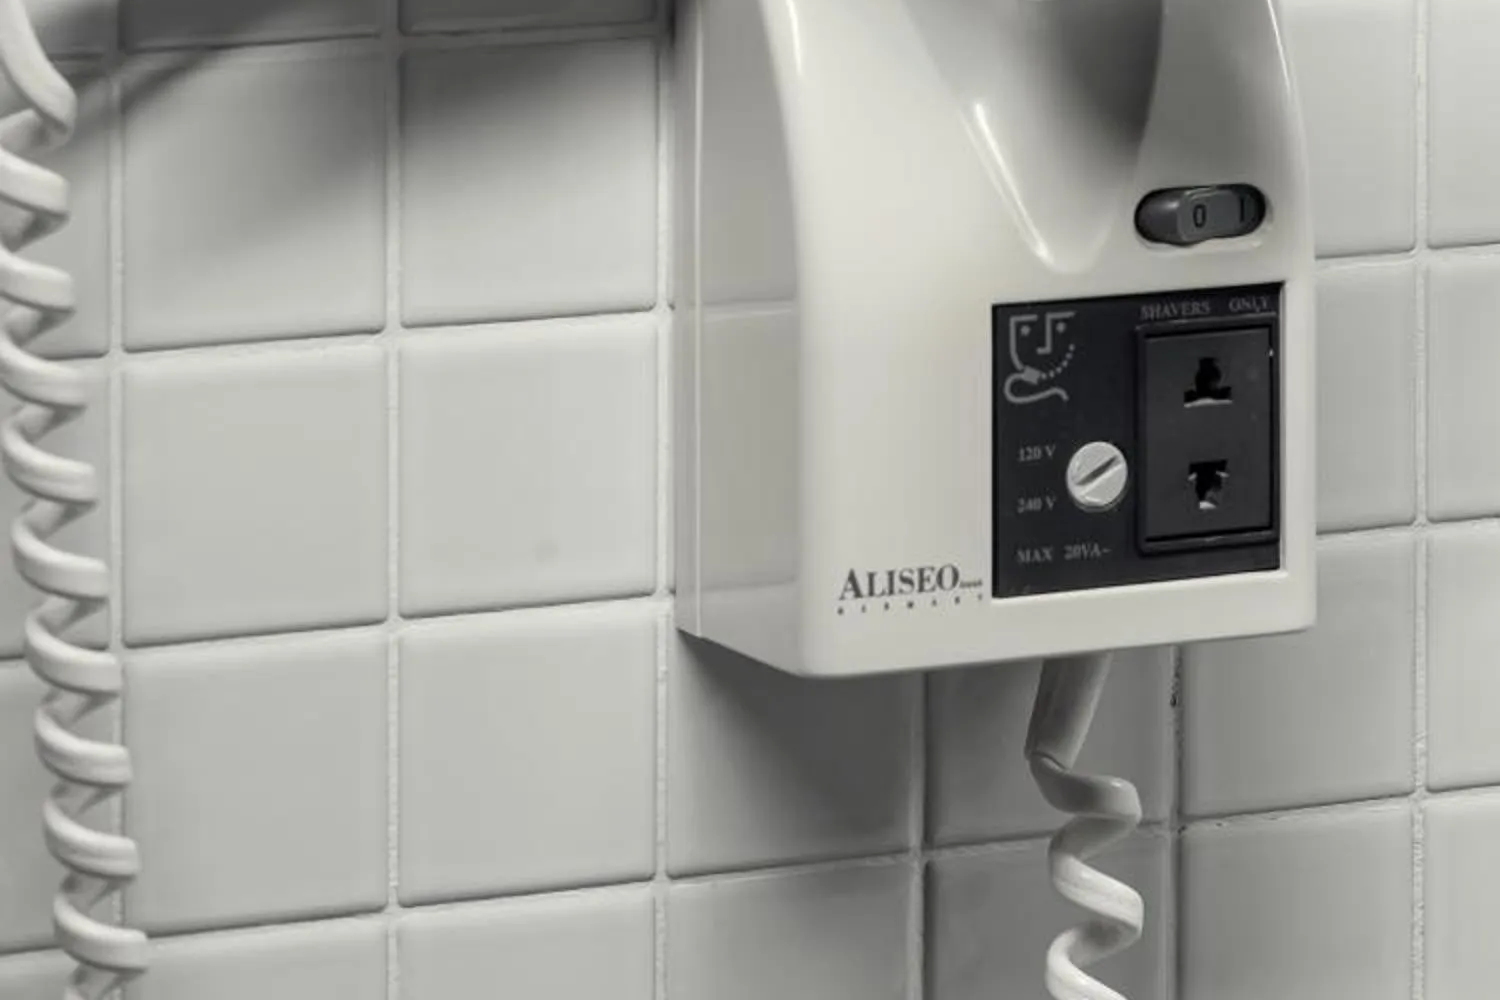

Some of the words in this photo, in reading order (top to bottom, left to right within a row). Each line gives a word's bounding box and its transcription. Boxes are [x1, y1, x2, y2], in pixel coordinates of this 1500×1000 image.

[1140, 300, 1211, 321] SHAVERS
[1228, 296, 1270, 313] ONLY
[1019, 446, 1042, 462] 120
[1045, 444, 1056, 458] V
[1045, 495, 1056, 510] V
[1017, 547, 1053, 563] MAX
[838, 564, 960, 601] ALISEO
